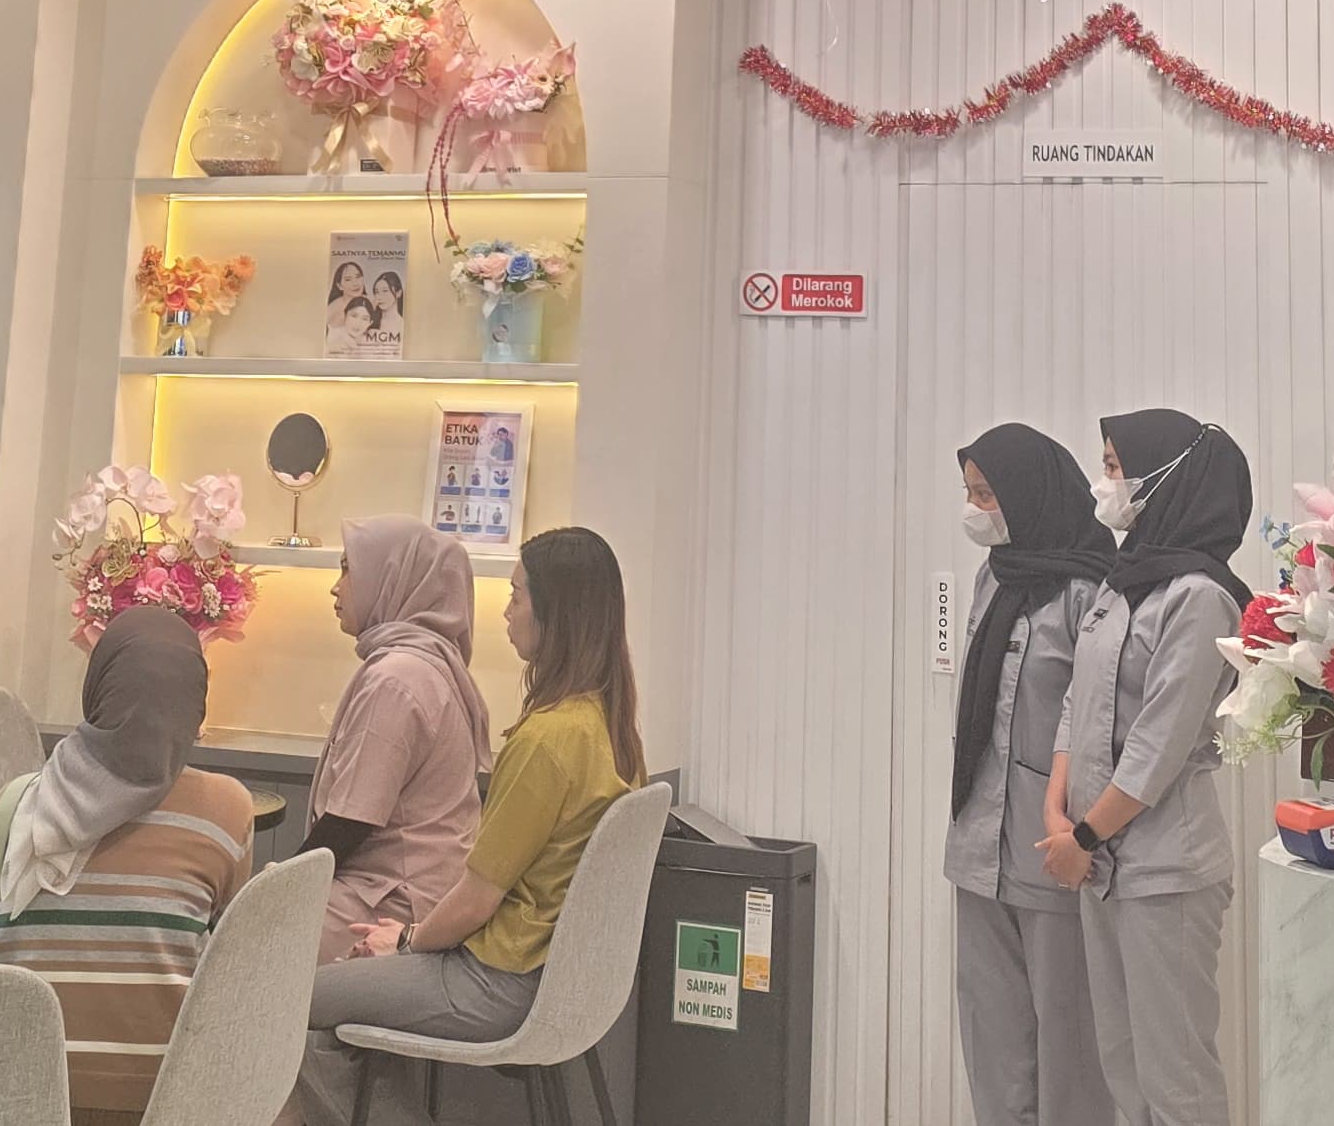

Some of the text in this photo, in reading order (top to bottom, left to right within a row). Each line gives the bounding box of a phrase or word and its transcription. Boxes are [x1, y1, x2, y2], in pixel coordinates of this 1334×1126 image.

[1032, 144, 1154, 162] RUANG TINDAKAN
[792, 277, 852, 294] Dilarang
[791, 294, 853, 308] Merokok
[366, 332, 401, 343] MGM
[446, 423, 479, 434] ETIKA
[444, 435, 482, 447] BATUK
[938, 582, 948, 652] DORONG
[686, 978, 727, 996] SAMPAH
[678, 1000, 733, 1020] NON MEDIS
